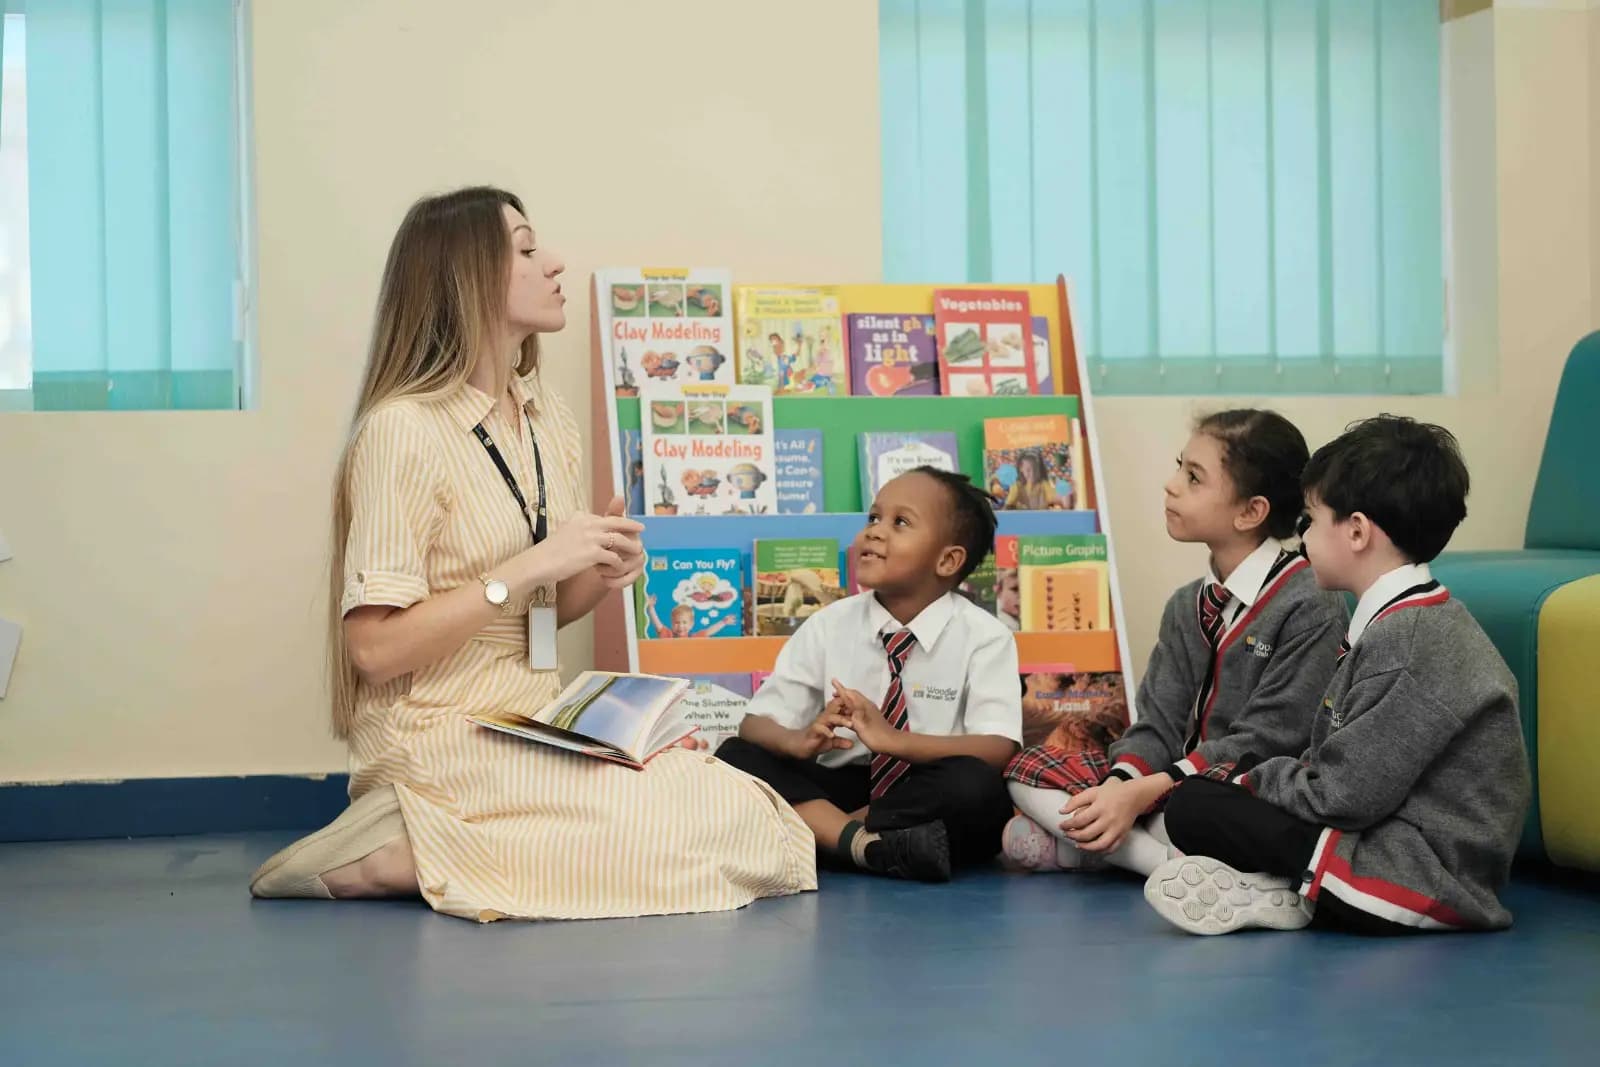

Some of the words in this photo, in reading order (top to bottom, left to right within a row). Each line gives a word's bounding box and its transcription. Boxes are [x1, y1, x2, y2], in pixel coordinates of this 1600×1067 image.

[940, 298, 1022, 312] Vegetables
[857, 317, 900, 330] silent
[902, 317, 921, 332] gh
[614, 322, 647, 342] Clay
[652, 322, 720, 342] Modeling
[872, 333, 889, 343] as
[891, 330, 908, 343] in
[864, 344, 918, 365] light
[653, 439, 687, 460] Clay
[692, 439, 762, 460] Modeling
[775, 440, 788, 449] t's
[1023, 545, 1063, 556] Picture
[1066, 544, 1105, 556] Graphs
[672, 560, 693, 570] Can
[696, 560, 714, 569] You
[717, 559, 736, 571] Fly?
[702, 698, 747, 707] Slumbers
[702, 723, 738, 732] umbers
